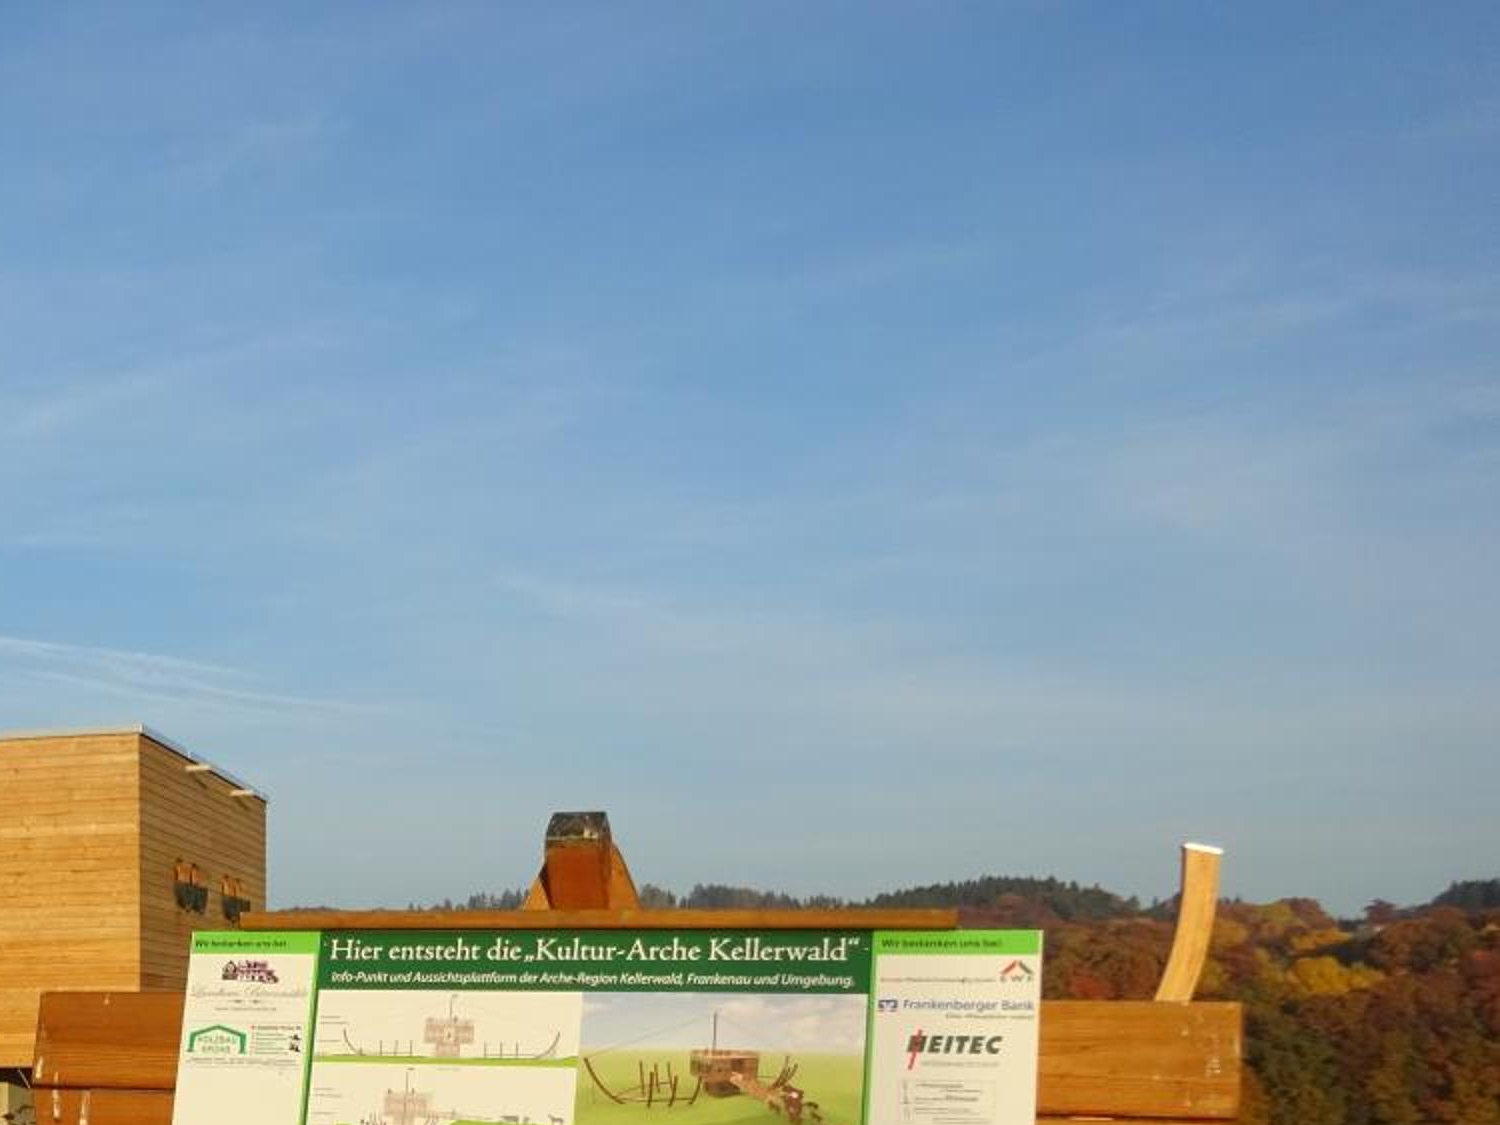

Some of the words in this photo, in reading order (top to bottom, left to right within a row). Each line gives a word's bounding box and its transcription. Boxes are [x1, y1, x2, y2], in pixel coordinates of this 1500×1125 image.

[330, 938, 383, 961] Hier
[389, 939, 480, 961] entsteht
[487, 938, 522, 961] die
[524, 938, 701, 962] „Kultur-Arche
[708, 937, 861, 961] Kellerwald“
[902, 938, 957, 948] bedanken
[331, 970, 387, 983] Info-Punkt
[389, 971, 411, 984] und
[413, 970, 517, 985] Aussichtsplattform
[519, 972, 537, 984] der
[539, 972, 618, 987] Arche-Region
[686, 974, 751, 986] Frankenau
[753, 974, 780, 986] und
[903, 998, 998, 1013] Frankenberger
[1001, 1001, 1034, 1012] Bank
